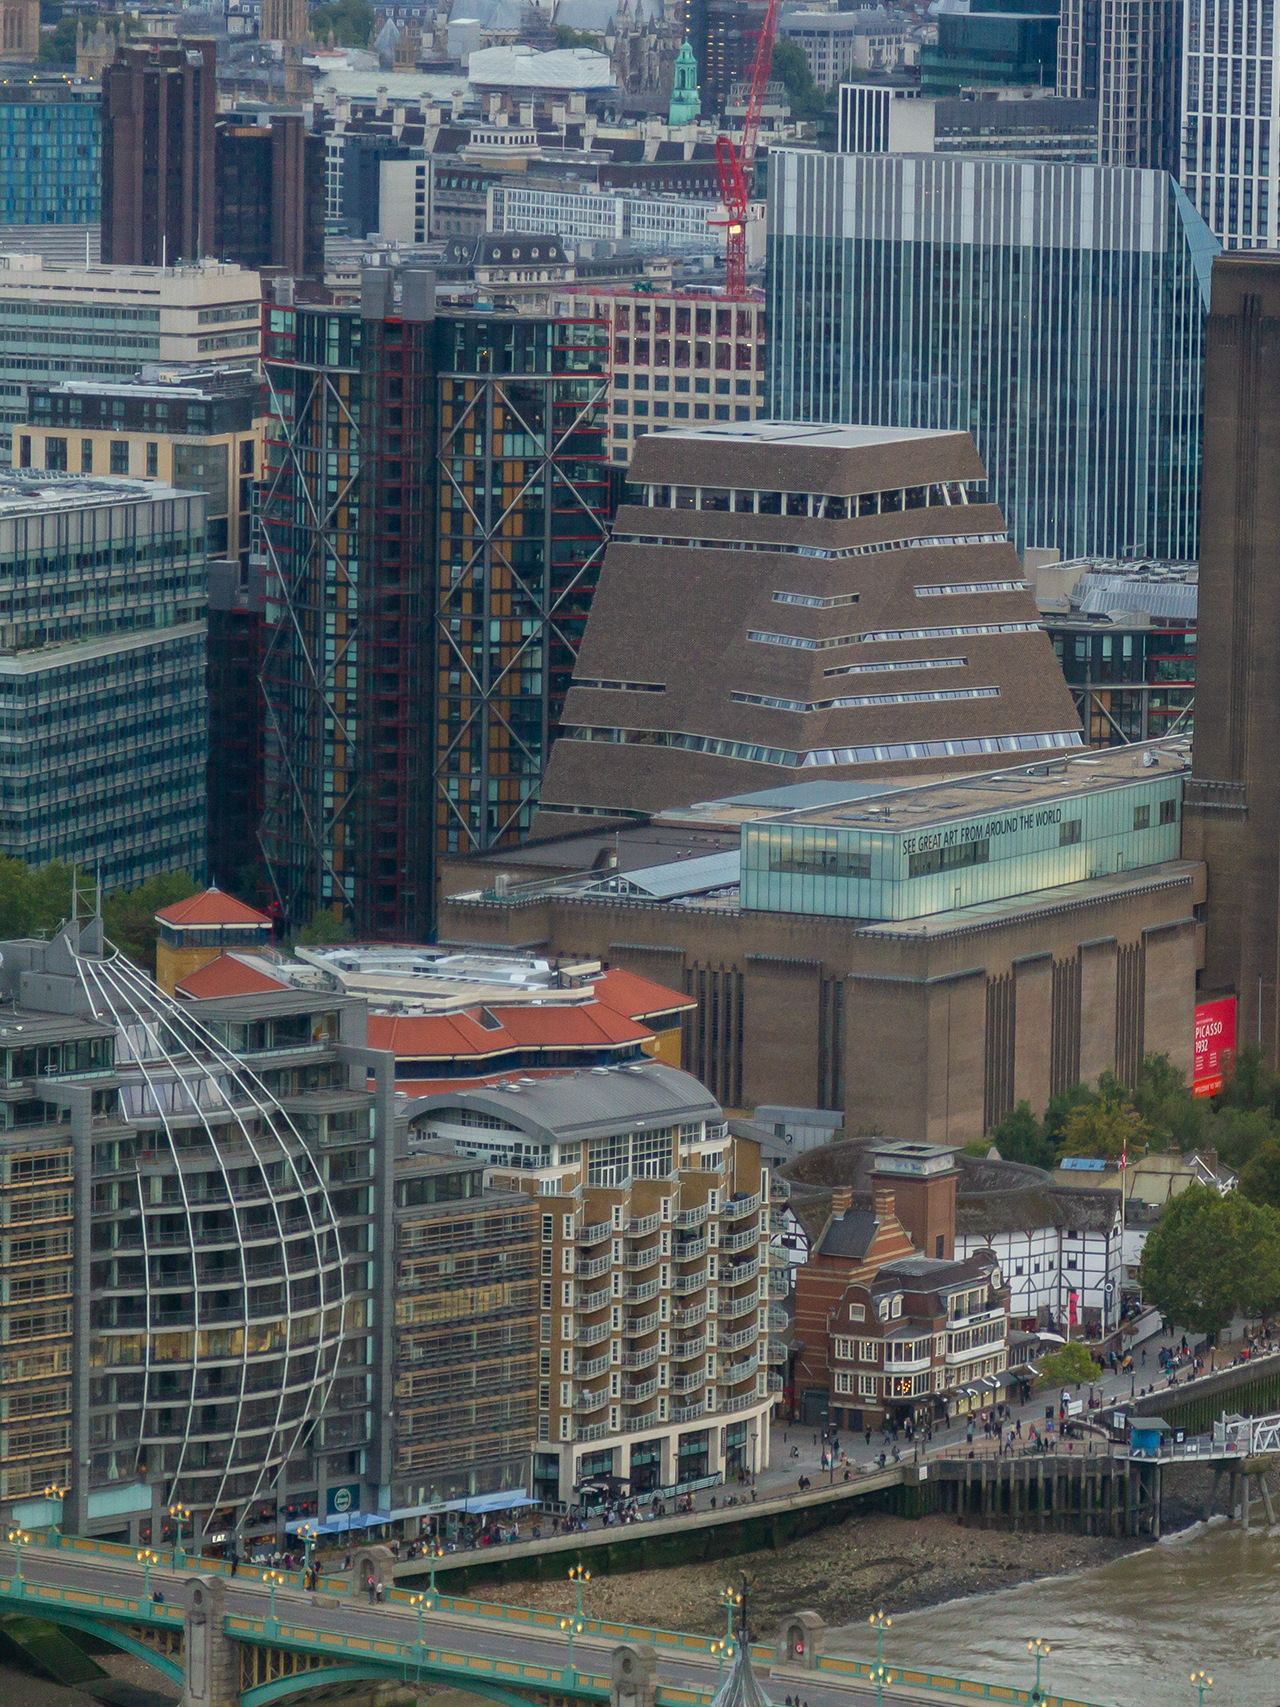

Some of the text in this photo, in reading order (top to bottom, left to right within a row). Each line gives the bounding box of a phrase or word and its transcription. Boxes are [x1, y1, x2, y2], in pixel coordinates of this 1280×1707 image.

[903, 809, 1061, 855] SEE GREAT ART FROM AROUND THE WORLD
[1195, 1021, 1222, 1039] PICASSO
[1195, 1039, 1208, 1053] 1932
